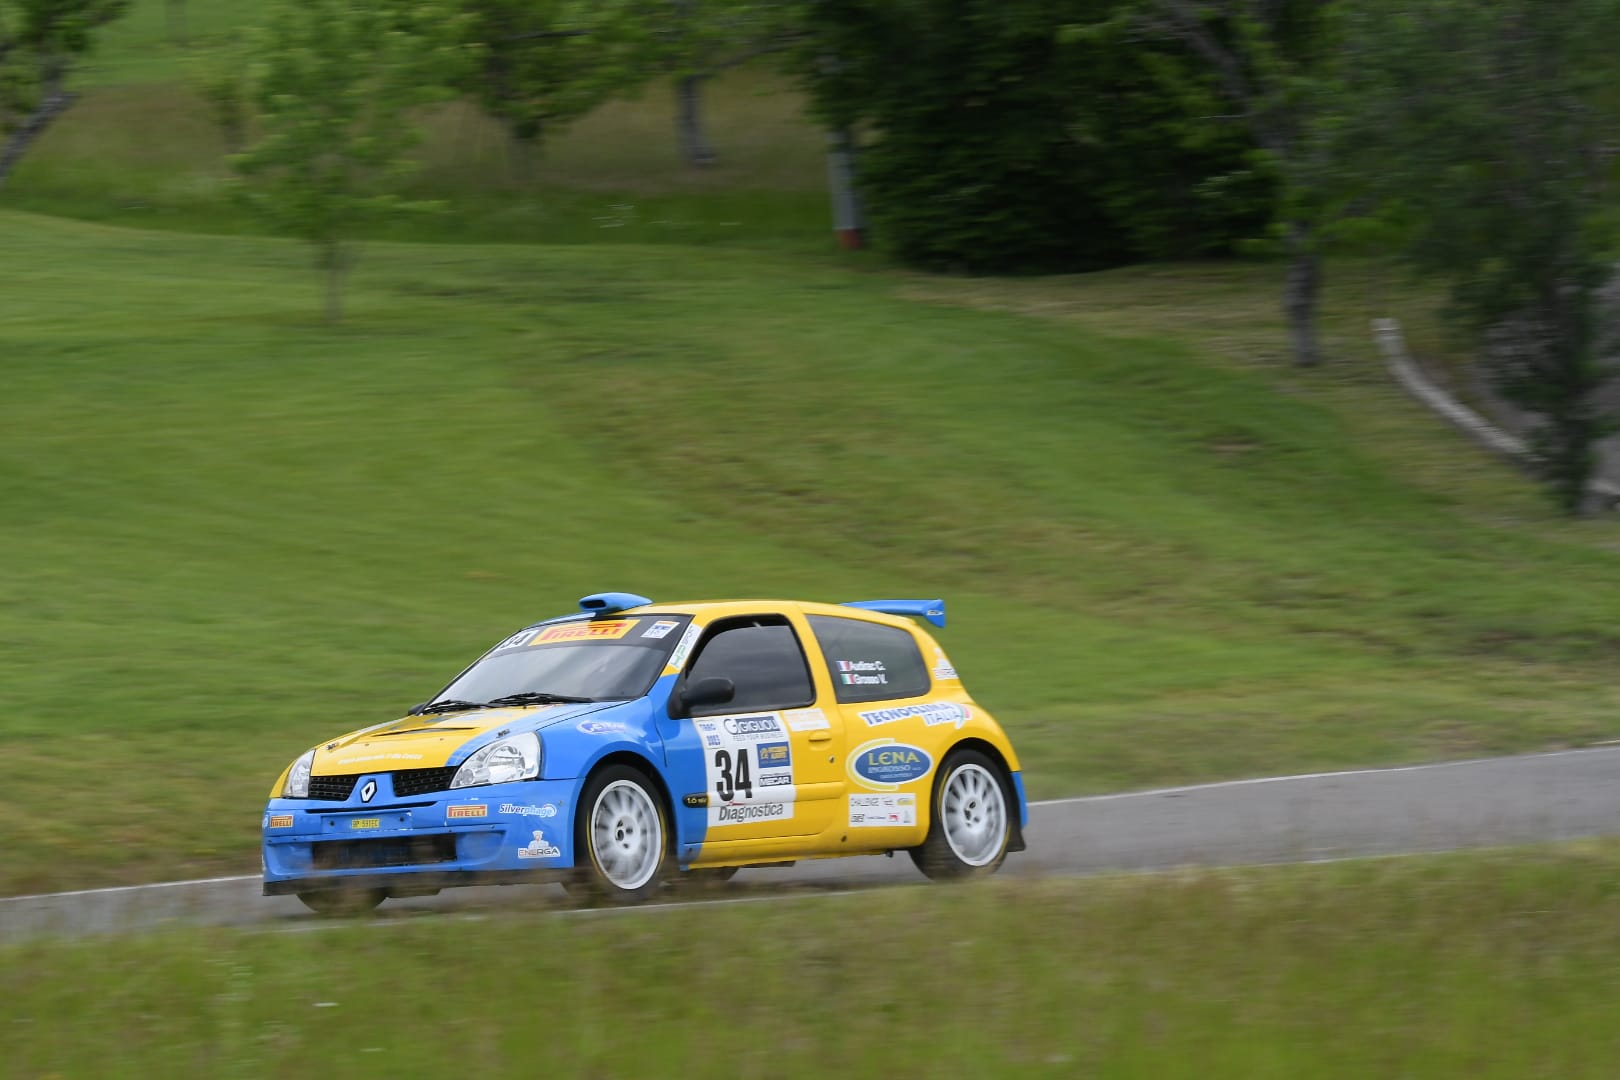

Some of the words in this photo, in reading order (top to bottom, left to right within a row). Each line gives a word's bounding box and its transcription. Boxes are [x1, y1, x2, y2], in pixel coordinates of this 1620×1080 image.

[541, 622, 627, 641] PIRELLI
[868, 752, 920, 766] LENA
[715, 749, 752, 801] 34
[448, 805, 486, 818] PIRELLI
[719, 802, 783, 822] Diagnostica
[271, 815, 293, 828] PIRELLI
[519, 847, 559, 856] ENERGA
